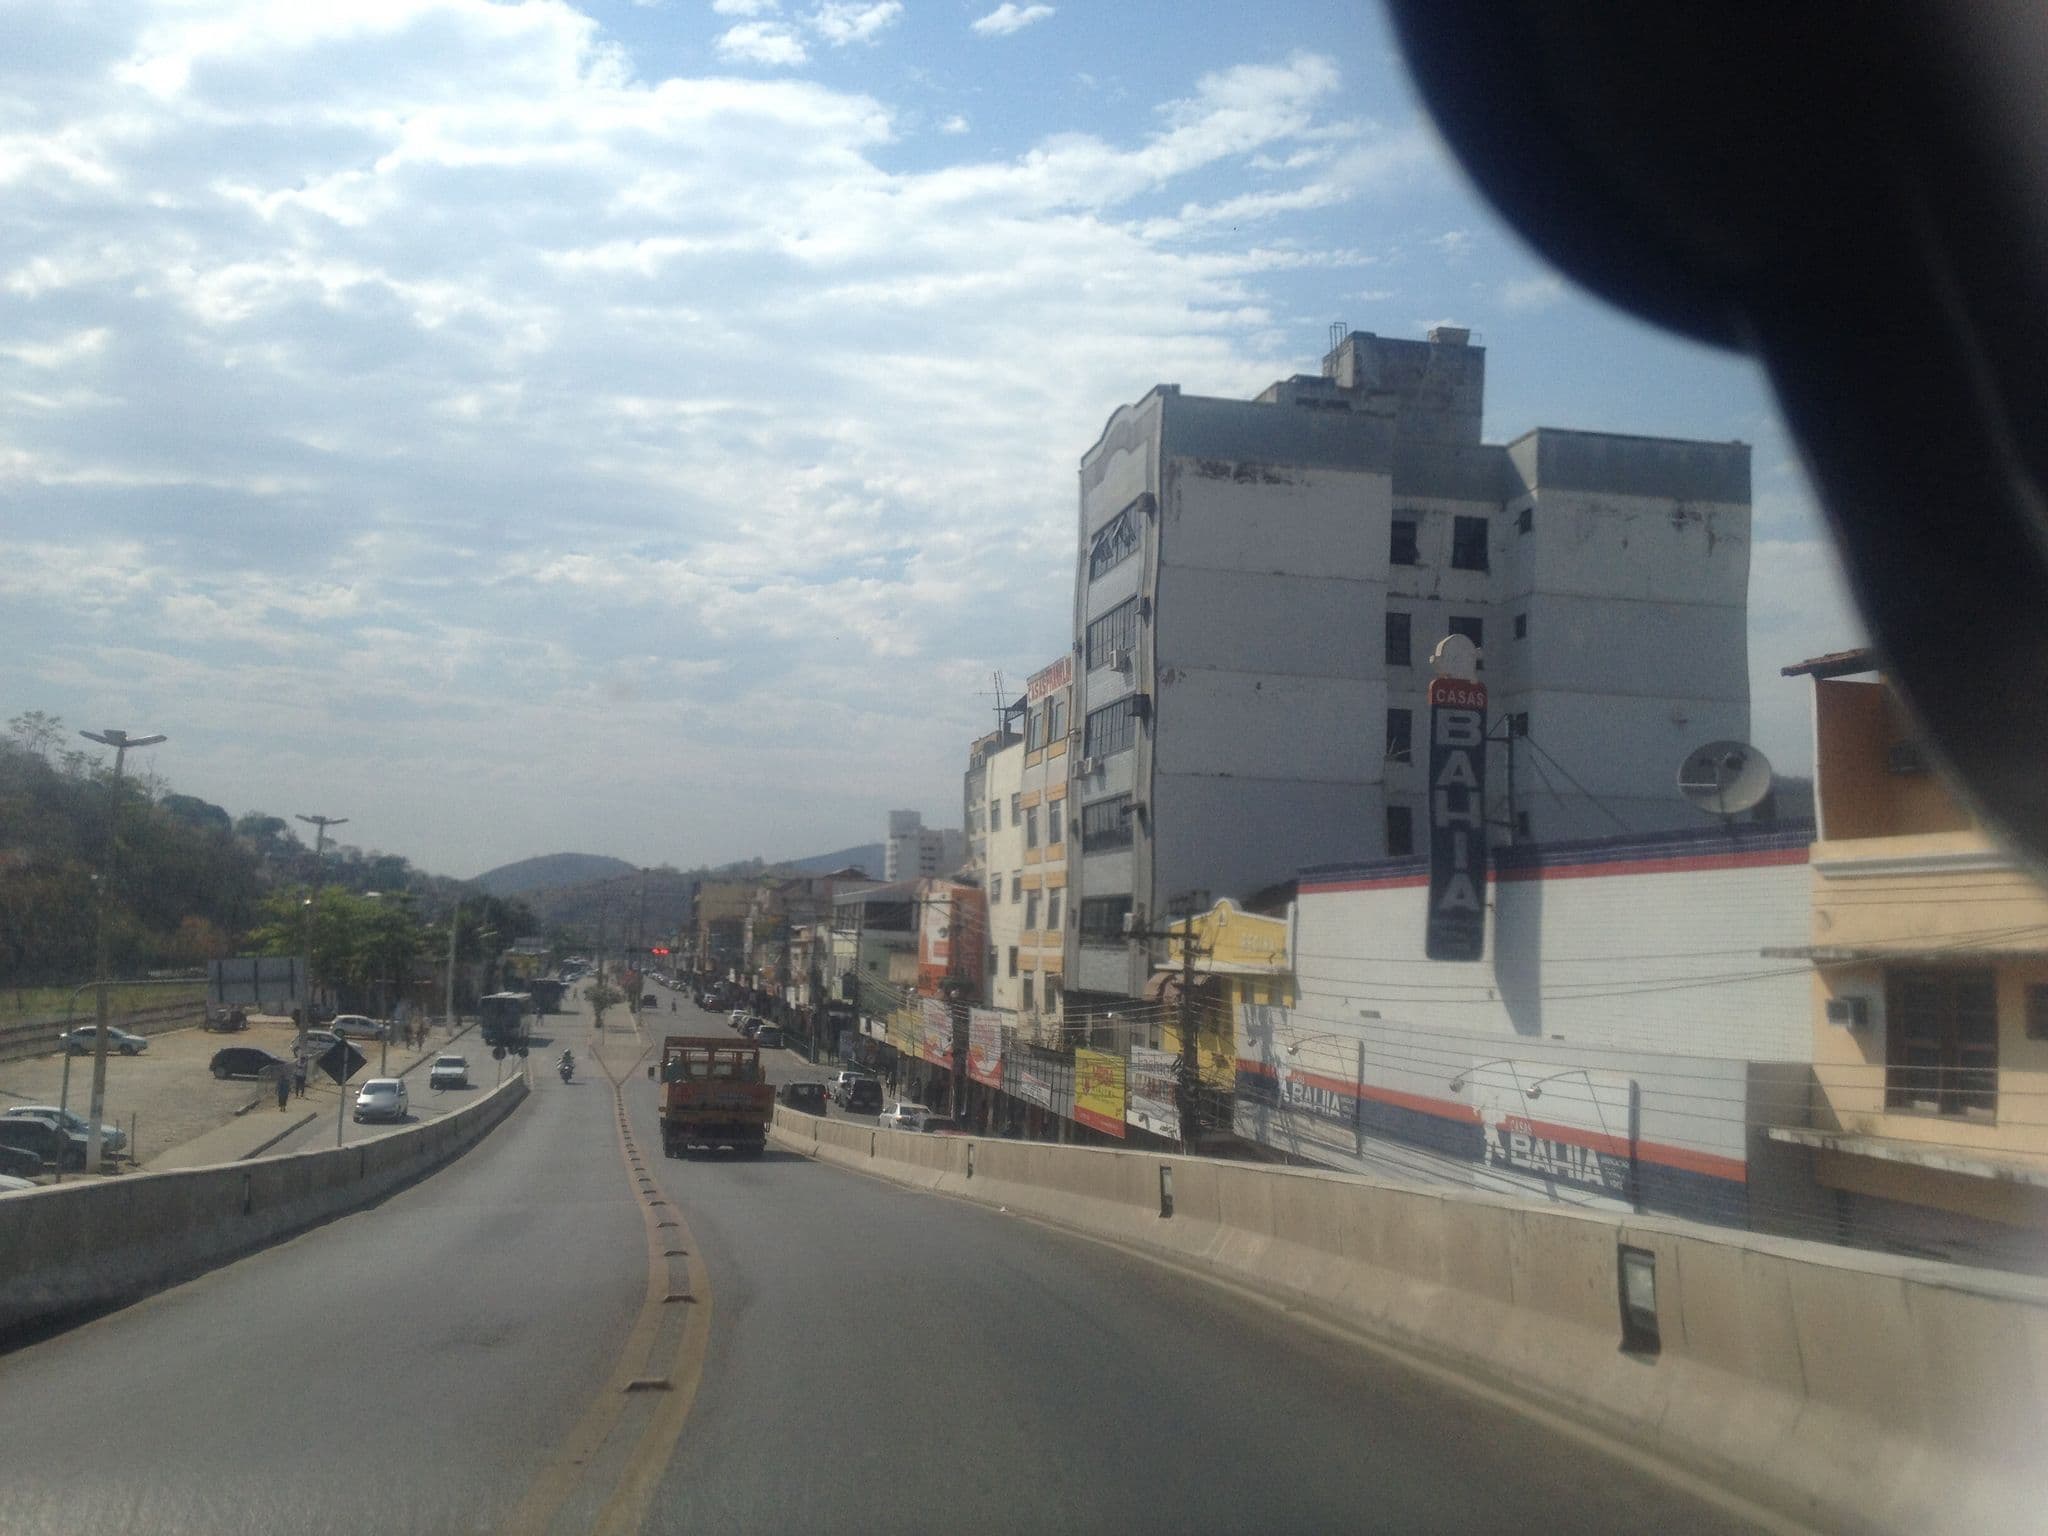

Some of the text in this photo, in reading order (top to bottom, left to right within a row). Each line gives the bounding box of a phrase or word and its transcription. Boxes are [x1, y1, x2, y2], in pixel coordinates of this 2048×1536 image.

[1437, 688, 1484, 707] CASAS
[1435, 709, 1482, 911] BAHIA
[1292, 1082, 1341, 1118] BAHIA
[1510, 1131, 1605, 1187] BAHIA
